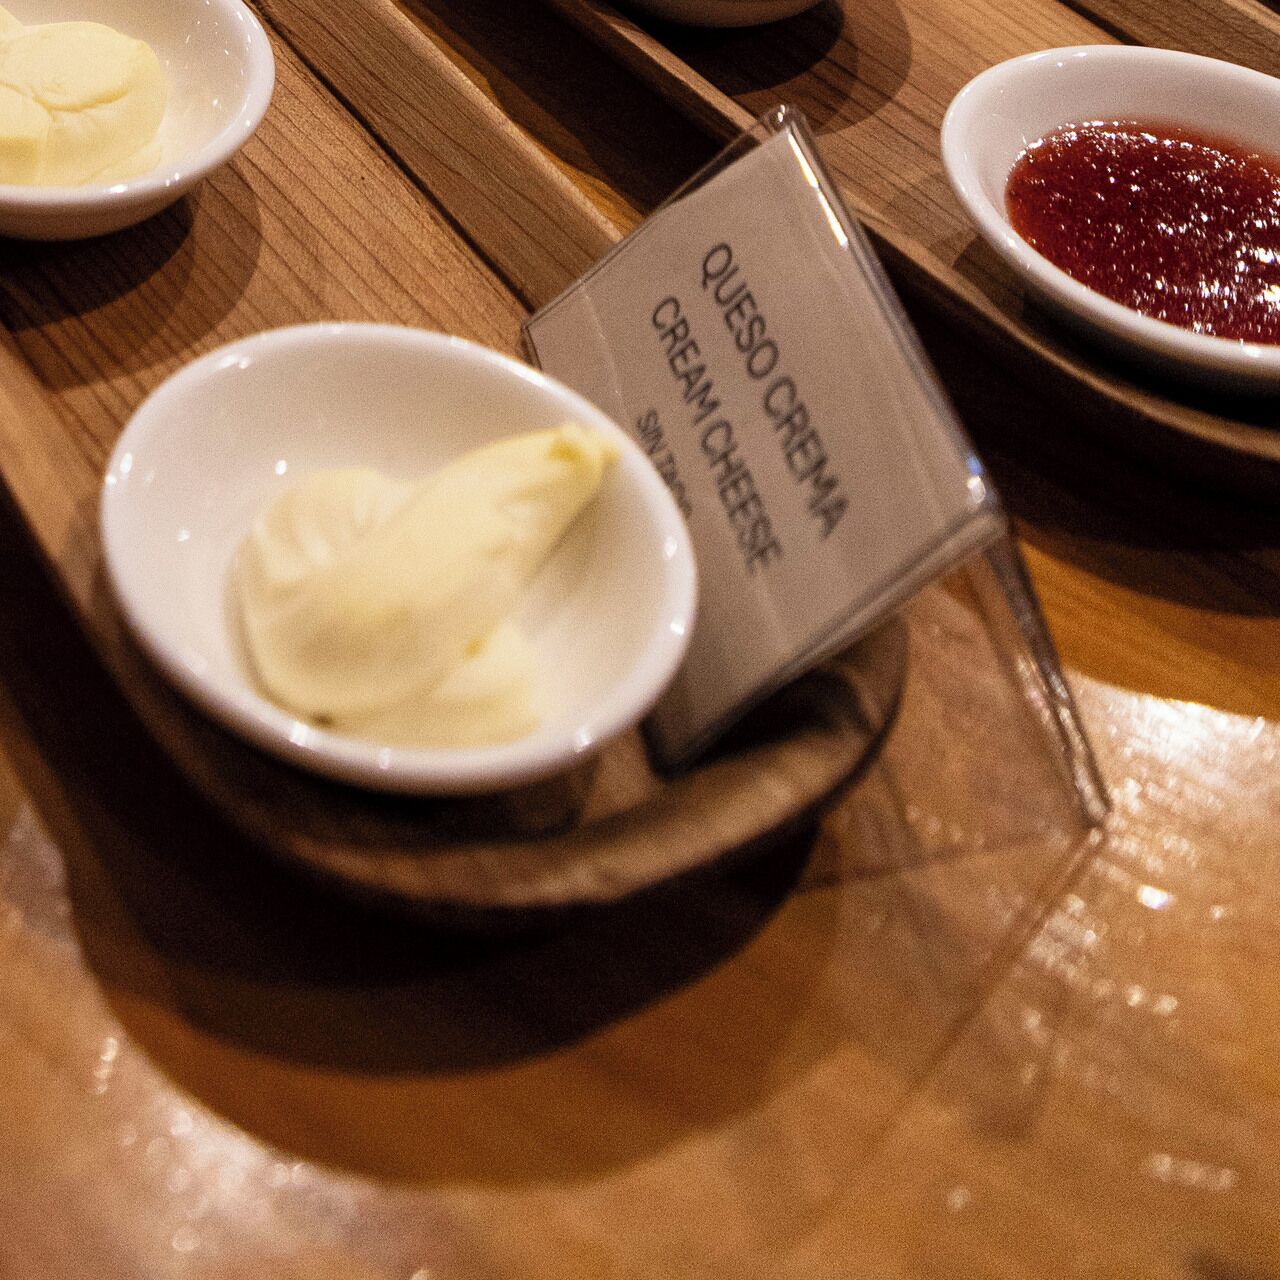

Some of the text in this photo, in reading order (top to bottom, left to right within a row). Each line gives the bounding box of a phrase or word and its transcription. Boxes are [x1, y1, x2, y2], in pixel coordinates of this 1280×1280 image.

[651, 296, 783, 576] CREAM CHEESE
[701, 242, 850, 539] QUESO CREMA
